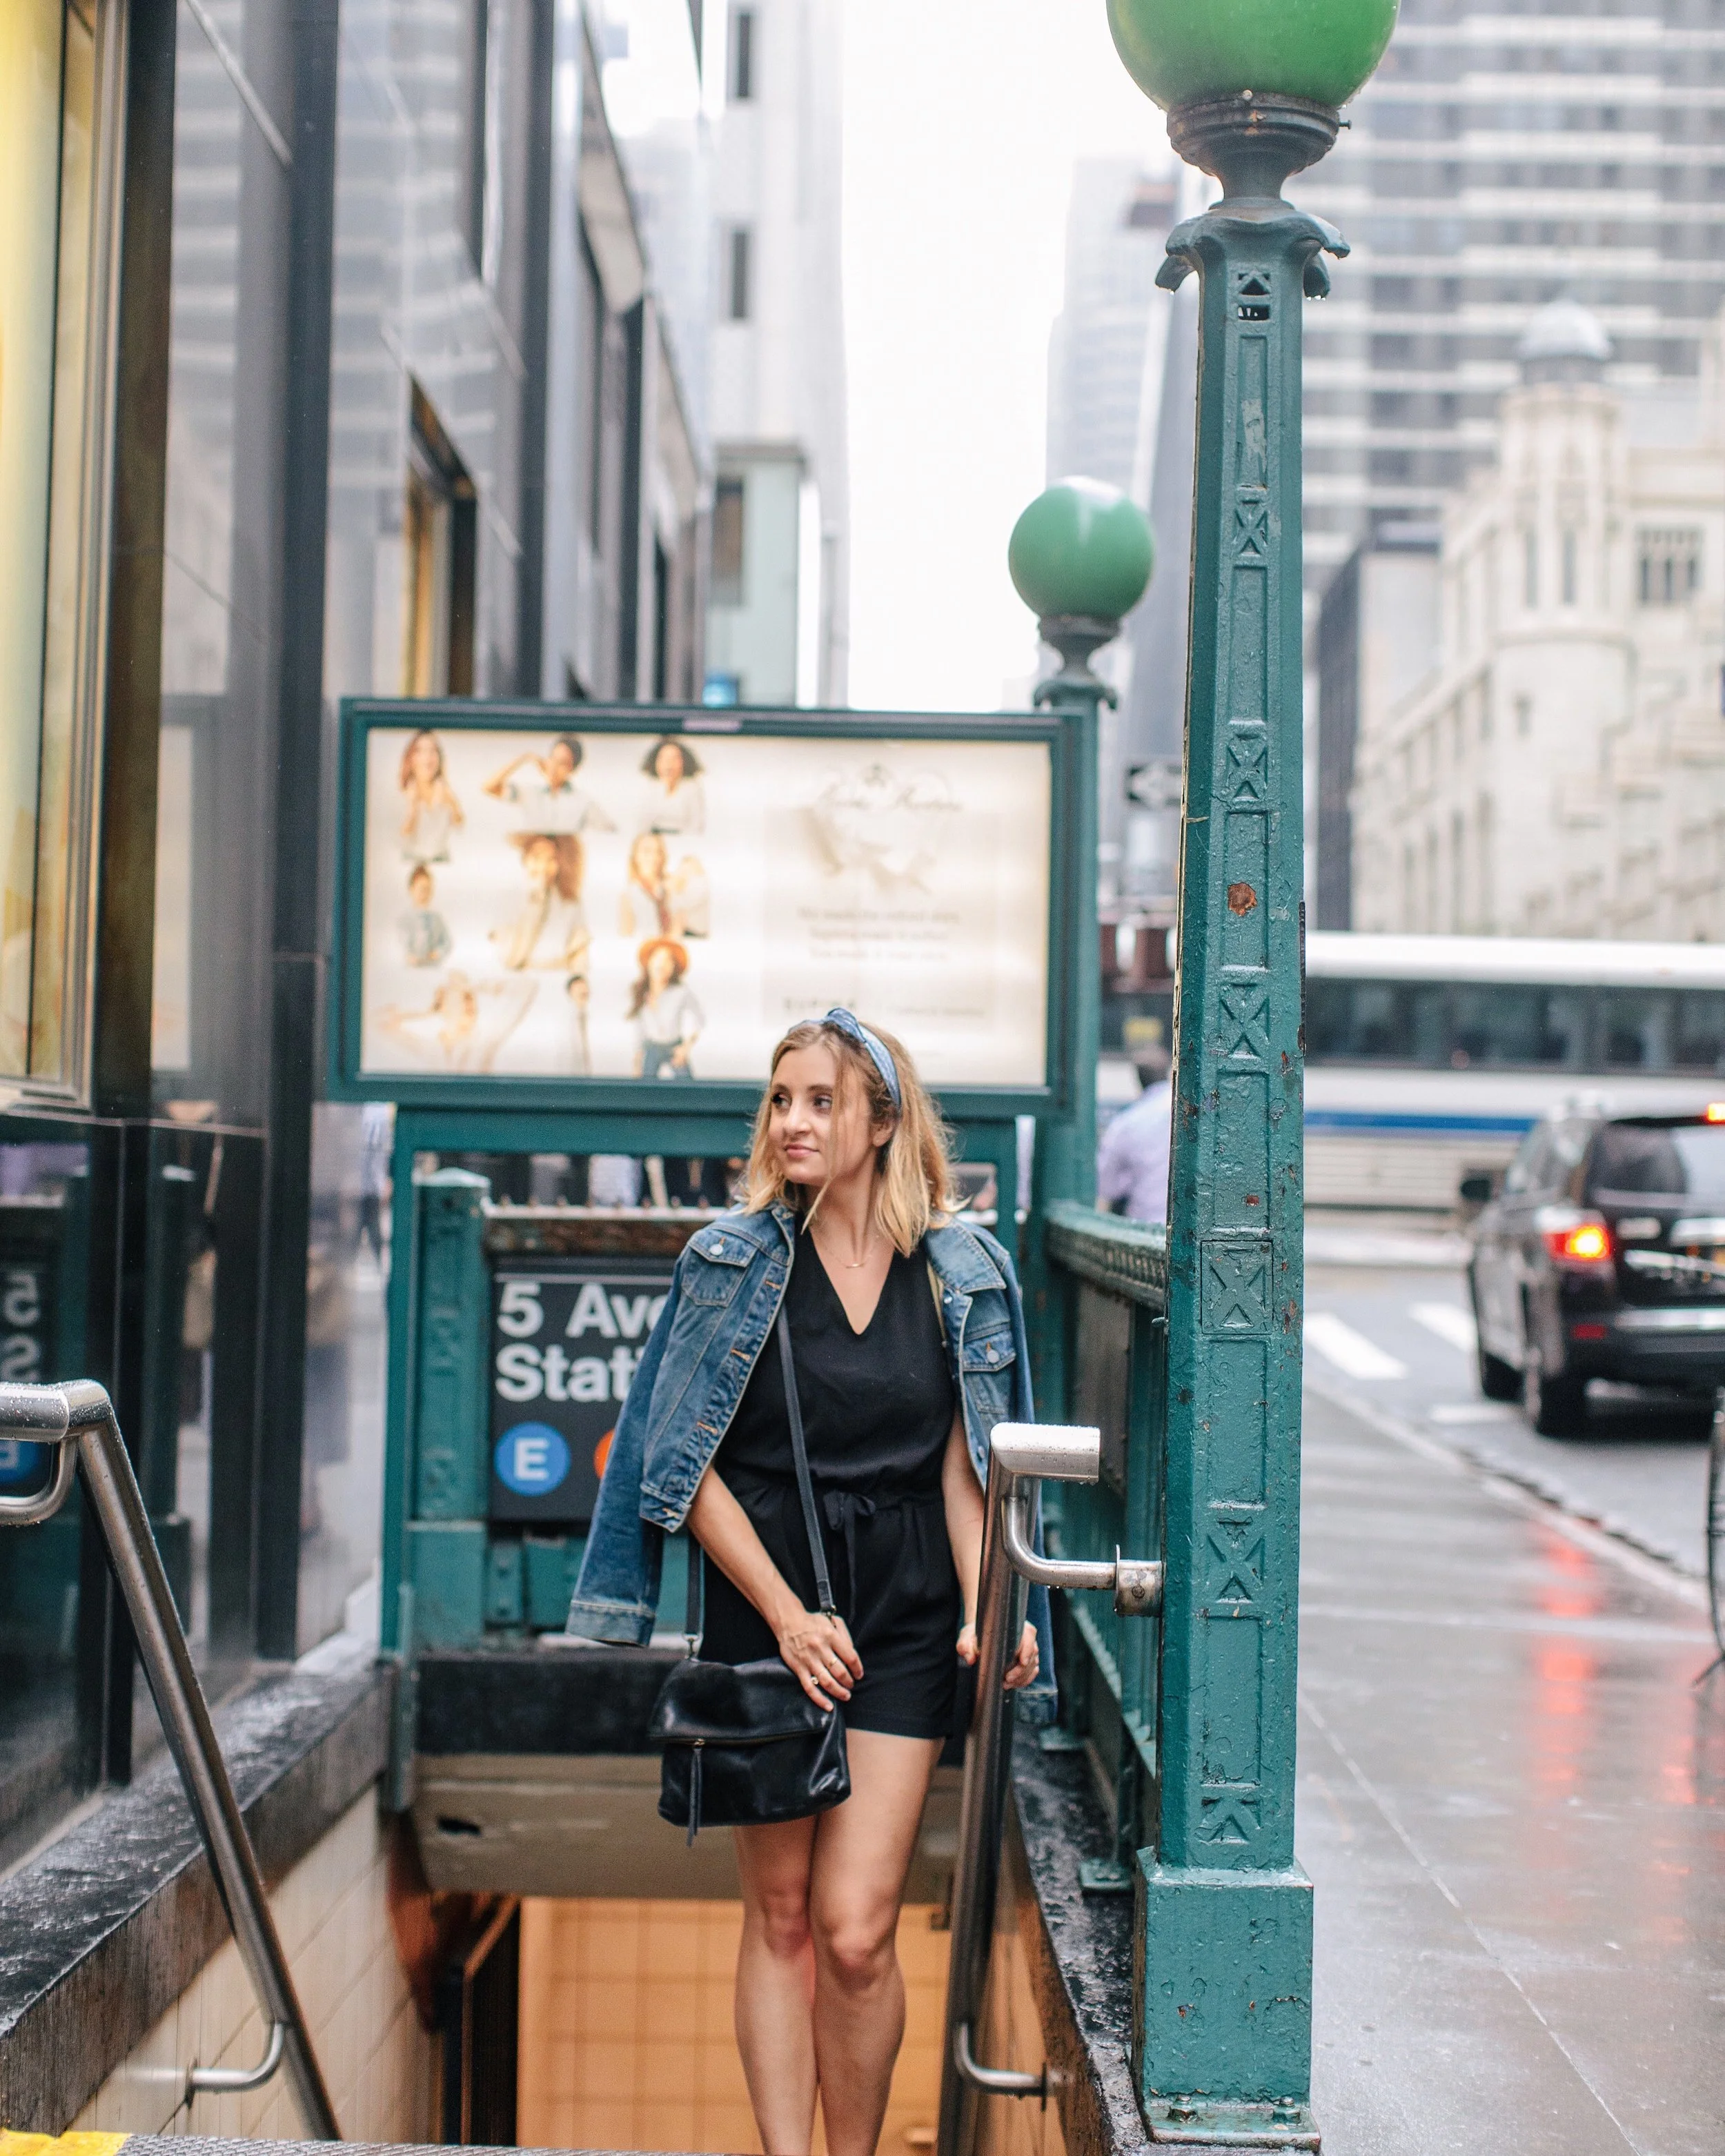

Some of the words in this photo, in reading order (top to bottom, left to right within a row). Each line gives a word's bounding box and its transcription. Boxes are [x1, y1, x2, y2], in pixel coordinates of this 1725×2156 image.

[497, 1282, 544, 1337] 5
[496, 1344, 644, 1401] Stat
[514, 1438, 549, 1481] E
